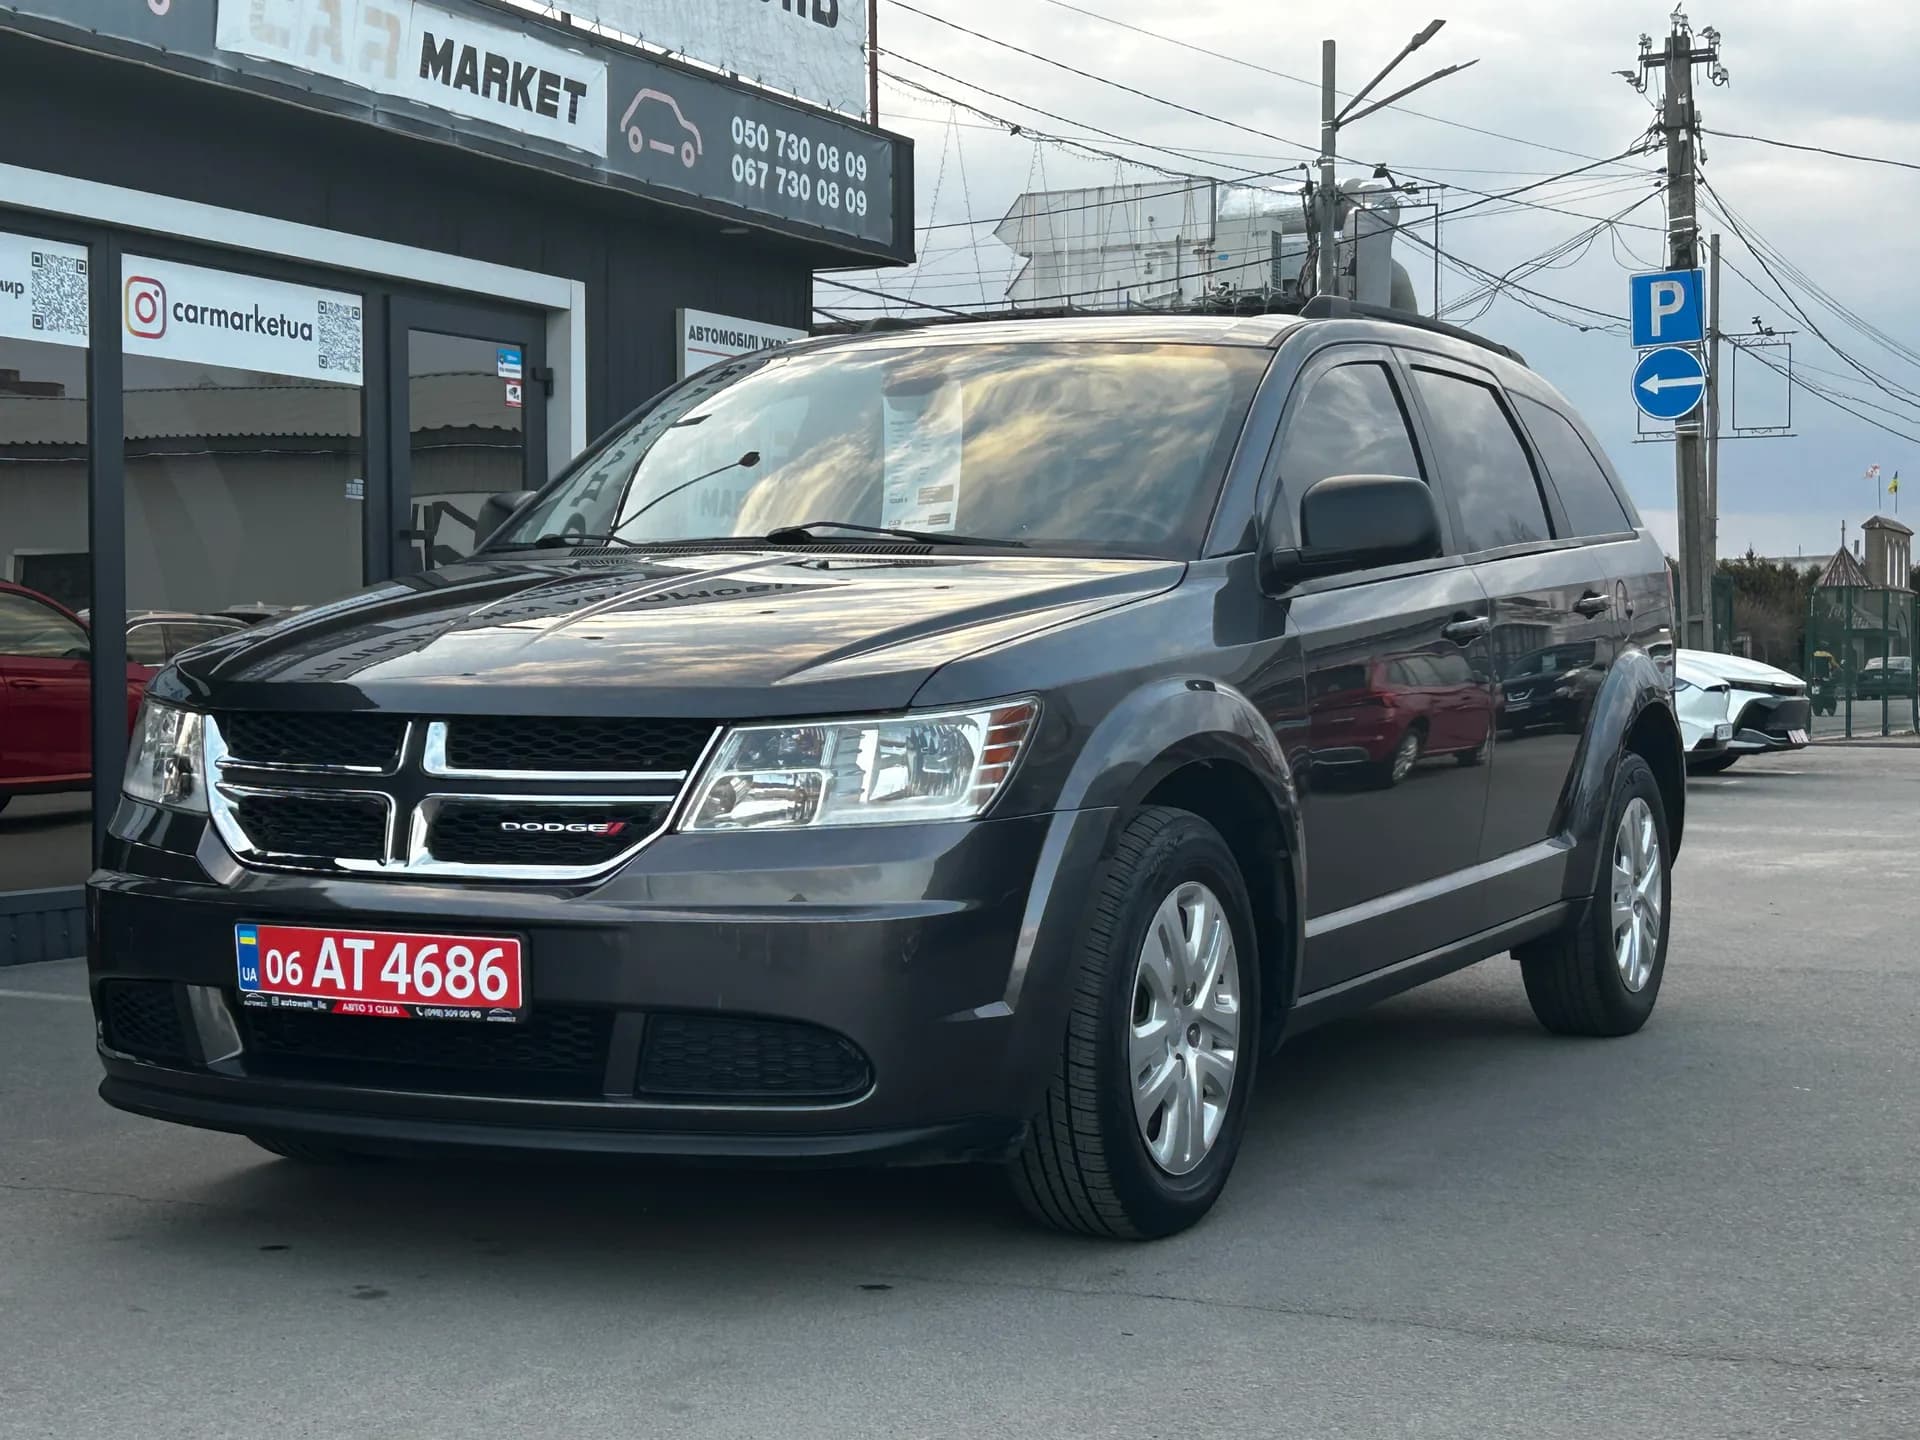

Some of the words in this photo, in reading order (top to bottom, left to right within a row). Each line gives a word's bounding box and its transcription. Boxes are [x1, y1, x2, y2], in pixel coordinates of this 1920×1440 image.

[419, 31, 588, 125] MARKET
[732, 115, 769, 153] 050
[776, 129, 811, 165] 730
[817, 142, 840, 175] 08
[845, 151, 868, 183] 09
[731, 153, 768, 190] 067
[775, 166, 811, 202] 730
[817, 178, 840, 210] 08
[845, 185, 868, 217] 09
[173, 299, 313, 342] carmarketua
[688, 324, 759, 350] АВТОМОБІЛІ
[1650, 280, 1685, 337] P
[501, 821, 610, 833] DODGE
[242, 966, 258, 982] UA
[265, 948, 303, 986] 06
[311, 937, 375, 991] AT
[380, 941, 508, 1001] 4686
[375, 1005, 400, 1015] США
